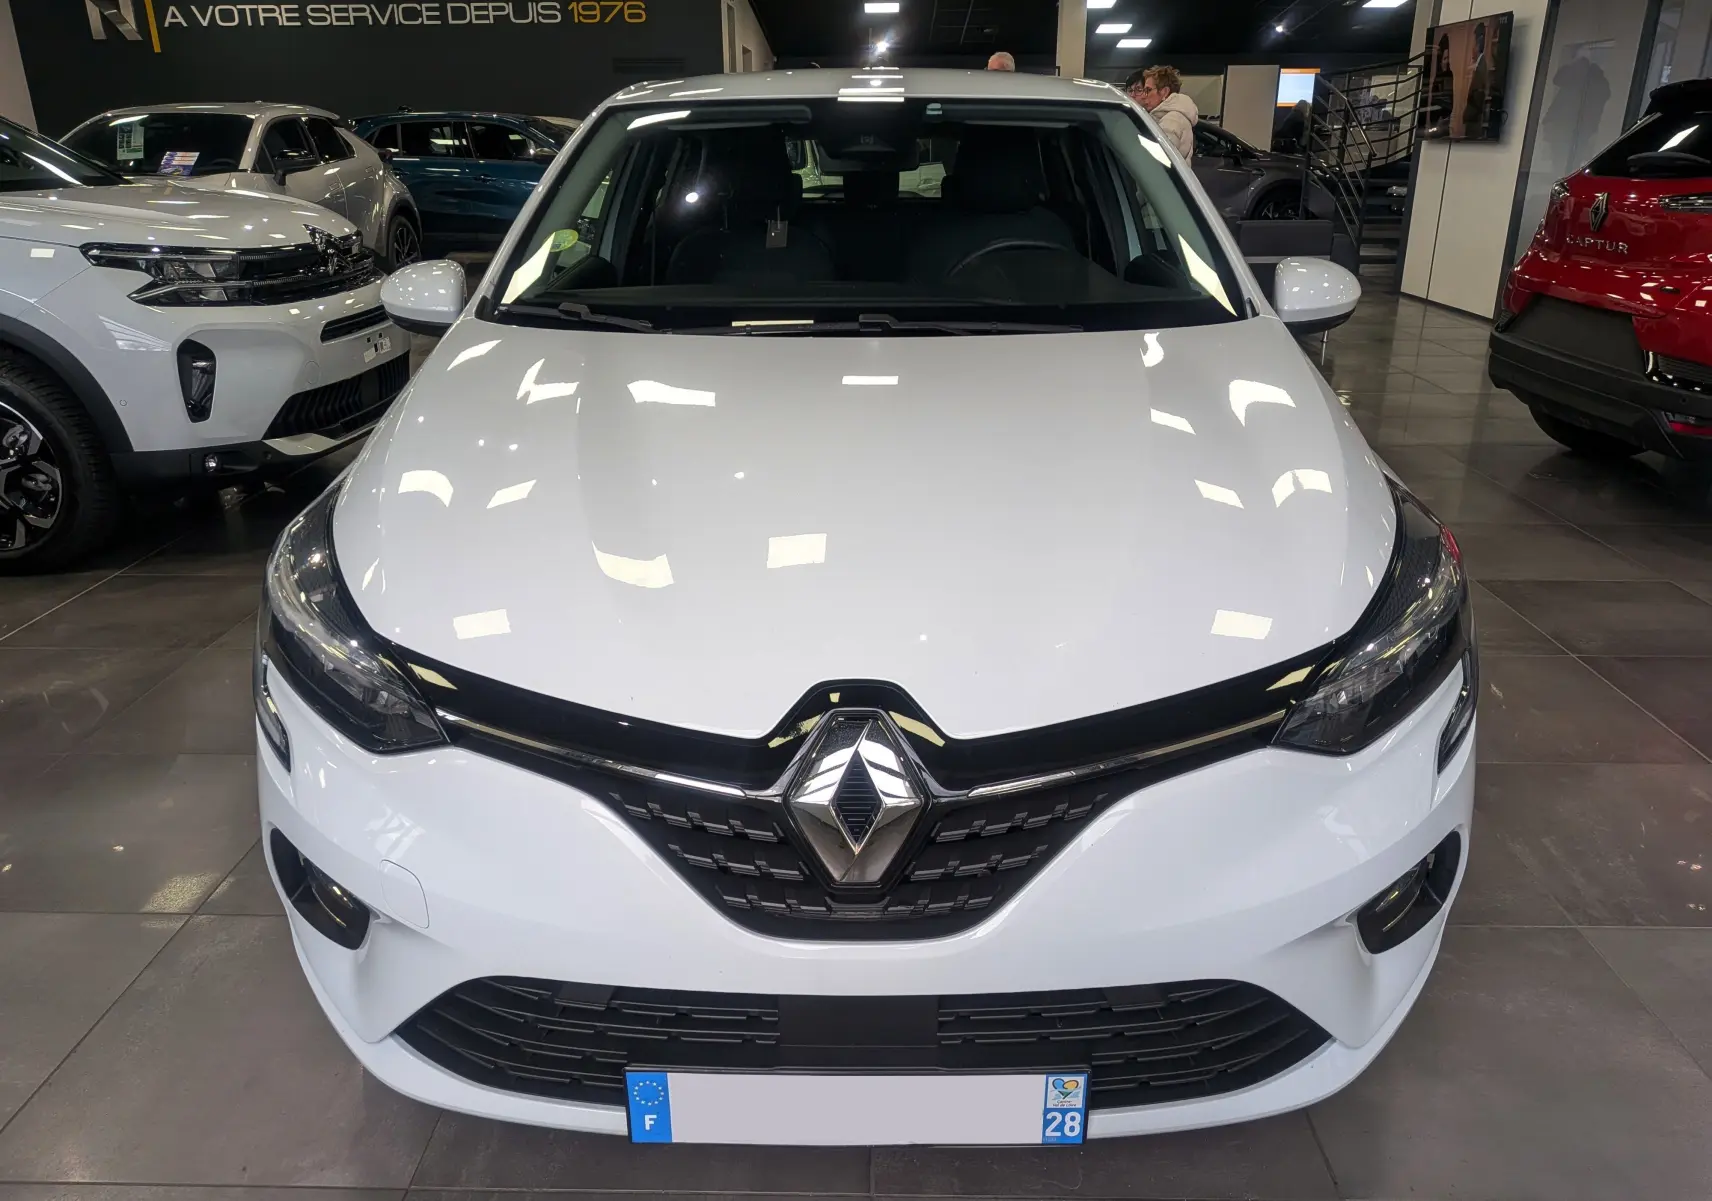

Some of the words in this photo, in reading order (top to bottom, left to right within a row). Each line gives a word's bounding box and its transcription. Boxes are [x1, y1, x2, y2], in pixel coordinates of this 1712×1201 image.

[190, 4, 301, 27] VOTRE
[306, 3, 441, 27] SERVICE
[447, 2, 561, 25] DEPUIS
[567, 1, 647, 23] 1976
[1566, 234, 1629, 255] CAPTUR
[644, 1114, 657, 1130] F
[1045, 1111, 1081, 1137] 28
